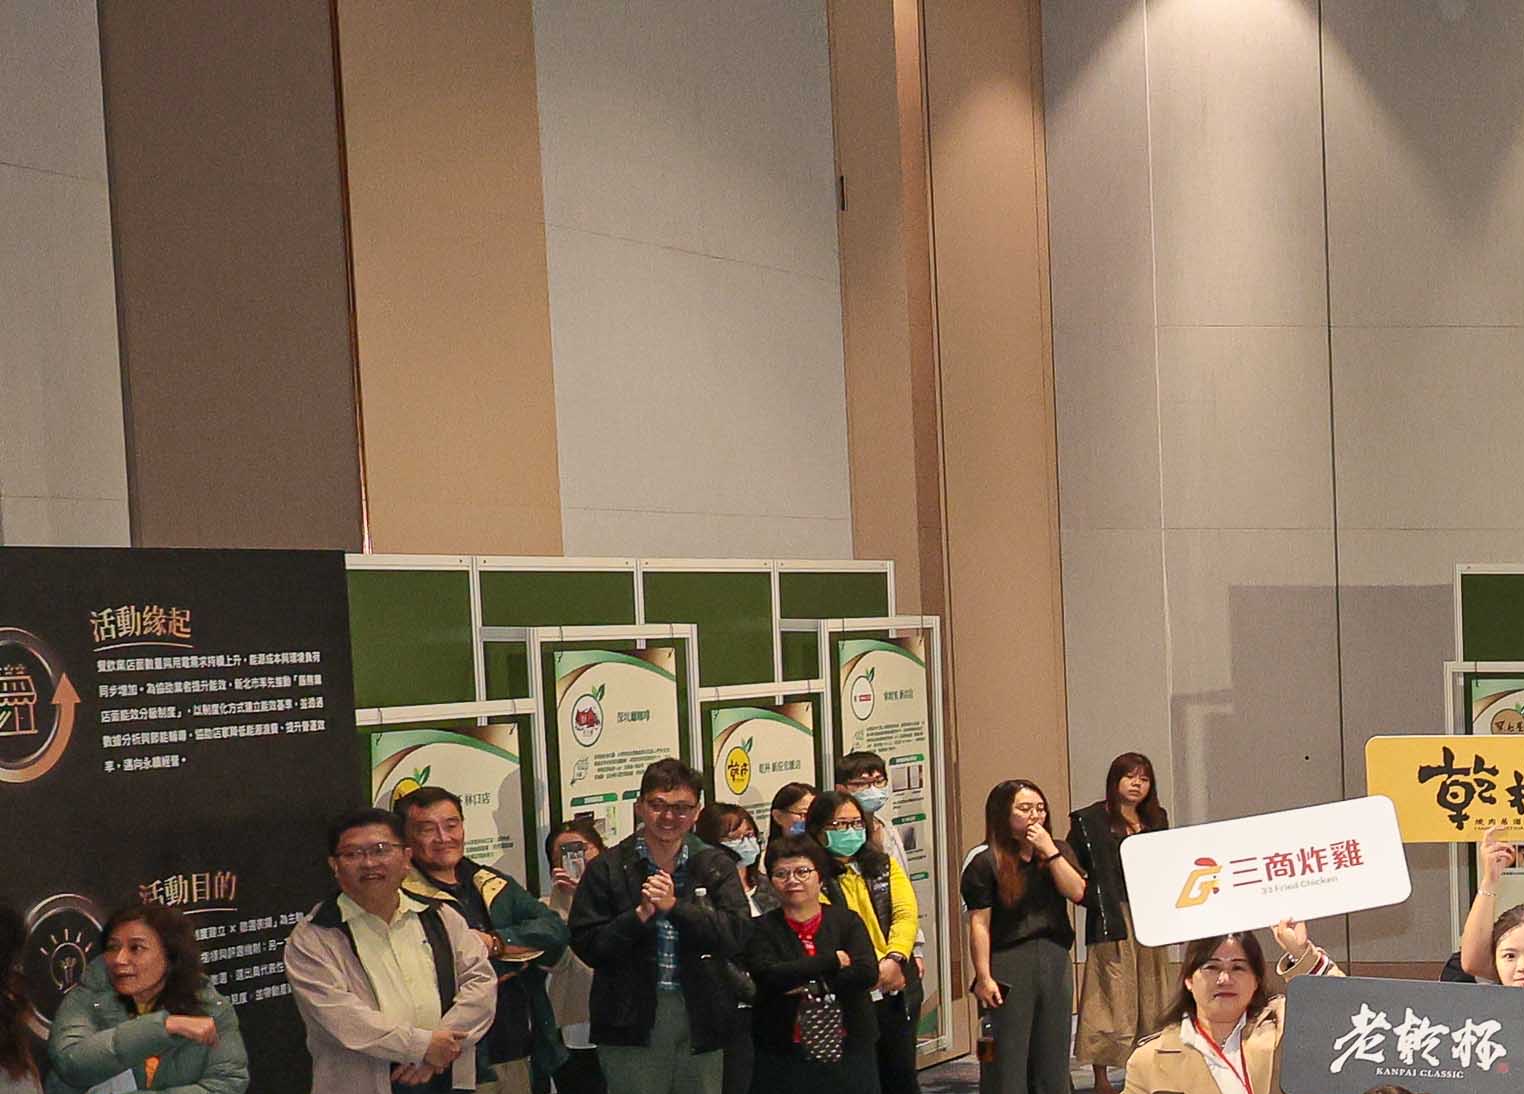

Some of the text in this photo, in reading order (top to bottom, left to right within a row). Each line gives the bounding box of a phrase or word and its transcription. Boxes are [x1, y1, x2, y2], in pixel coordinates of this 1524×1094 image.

[90, 604, 193, 642] 活動緣起
[1229, 838, 1364, 888] 三商炸雞
[139, 871, 237, 906] 活動目的
[1330, 1002, 1507, 1074] 老乾杯
[1375, 1066, 1464, 1079] KANPAI CLASSIC
